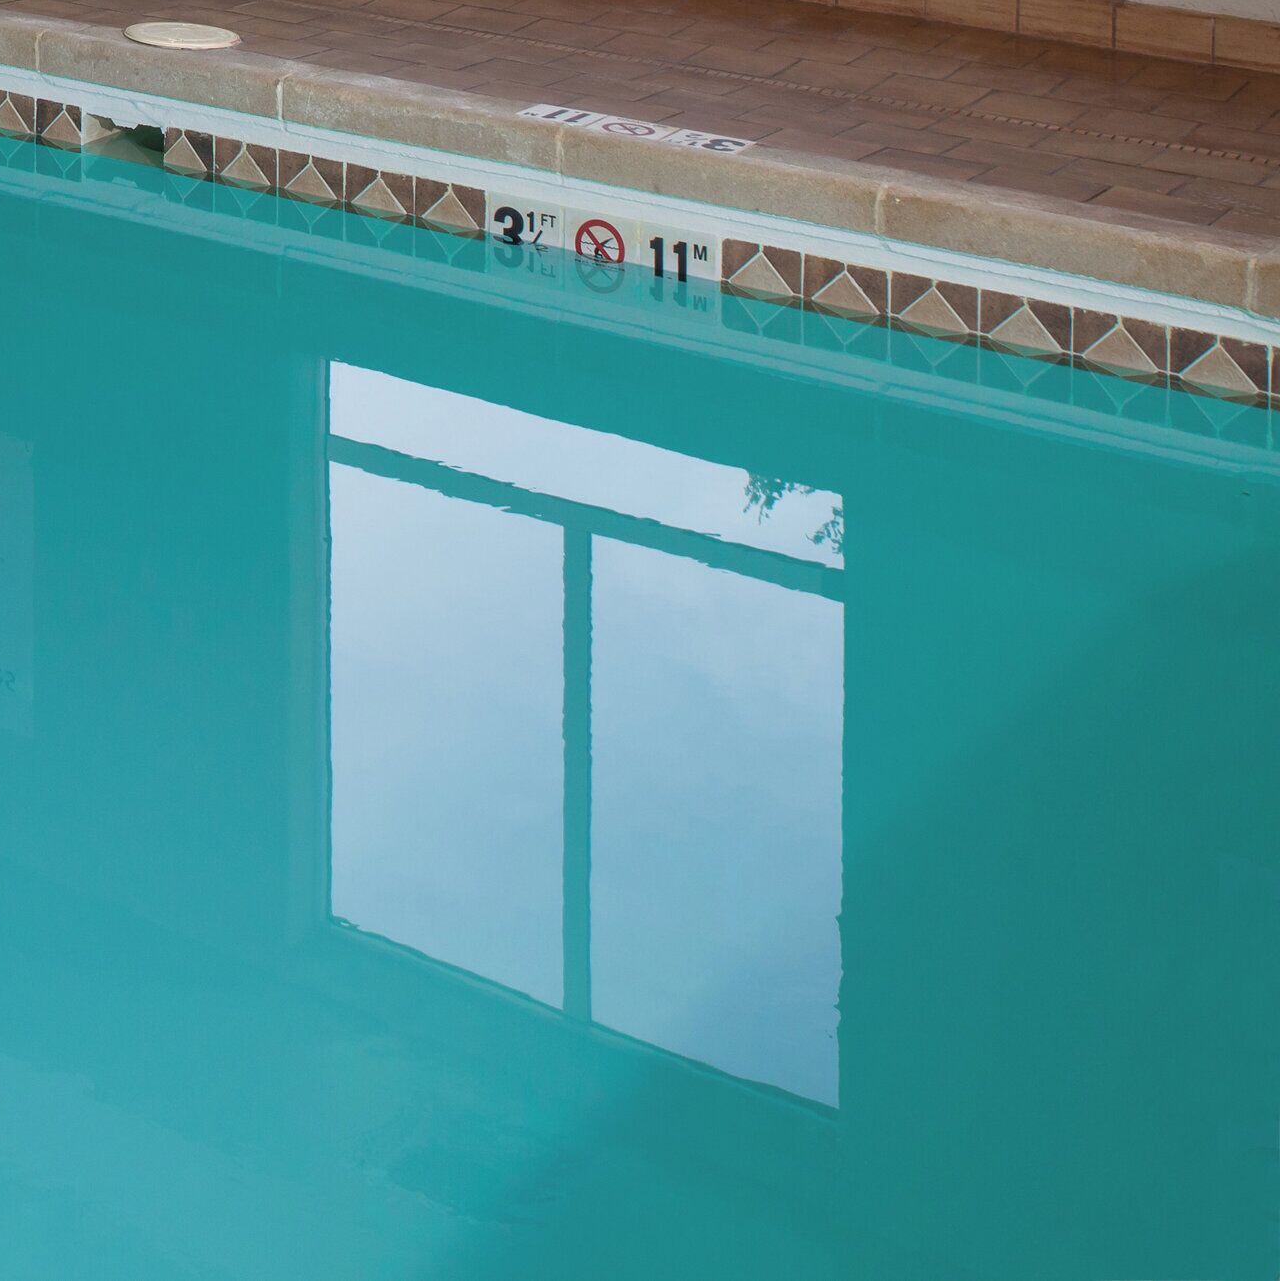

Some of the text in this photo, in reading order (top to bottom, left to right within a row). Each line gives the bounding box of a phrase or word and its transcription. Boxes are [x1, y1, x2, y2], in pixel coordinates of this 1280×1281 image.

[494, 207, 524, 245] 3
[541, 214, 556, 228] FT
[650, 237, 708, 282] 11 M
